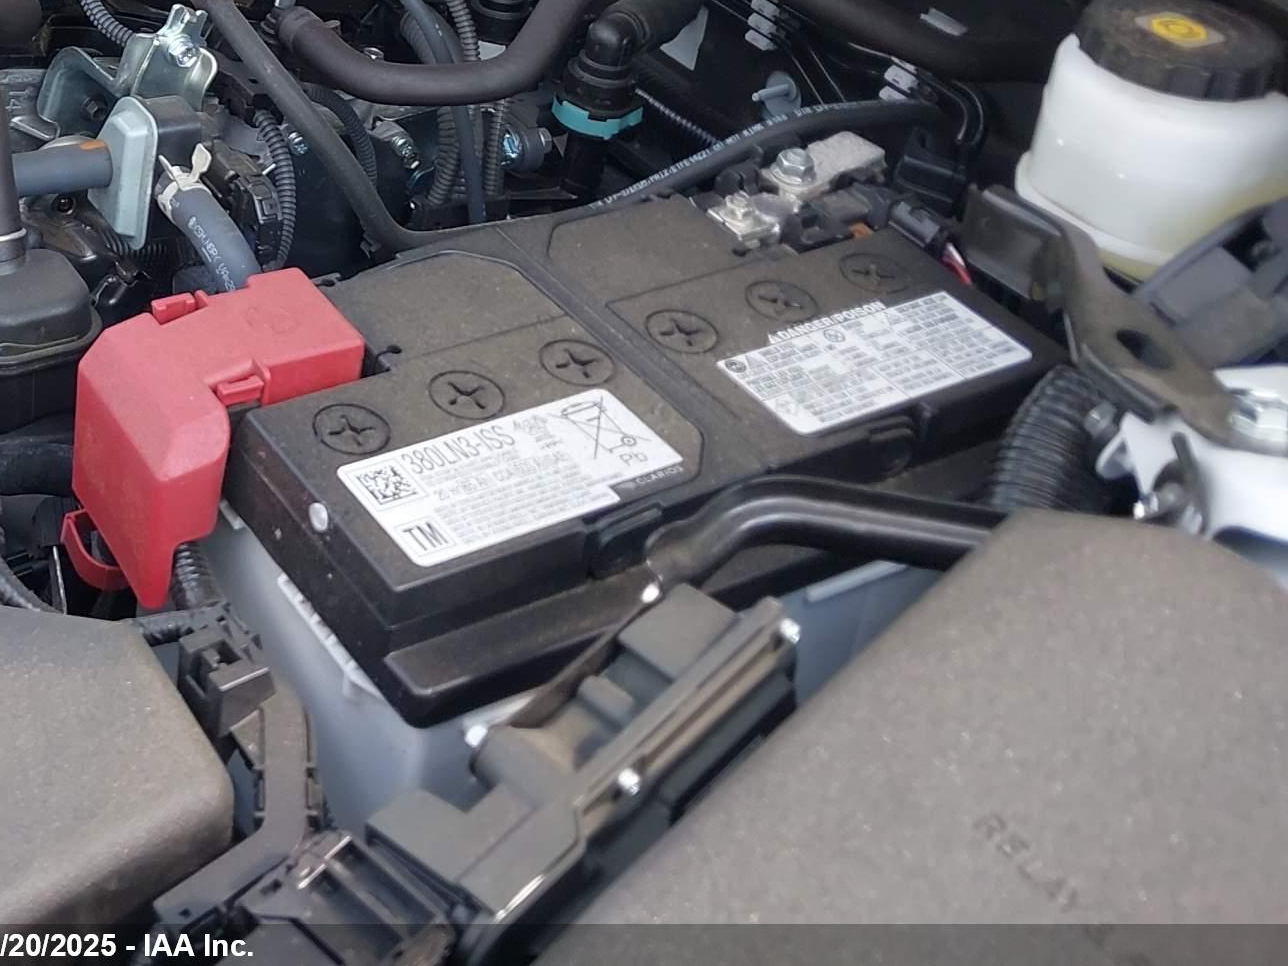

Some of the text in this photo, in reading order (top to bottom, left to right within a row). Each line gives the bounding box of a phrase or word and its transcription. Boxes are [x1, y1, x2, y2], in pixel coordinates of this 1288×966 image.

[401, 424, 516, 475] 380LN3-ISS
[619, 451, 649, 467] Pb
[402, 520, 450, 552] TM
